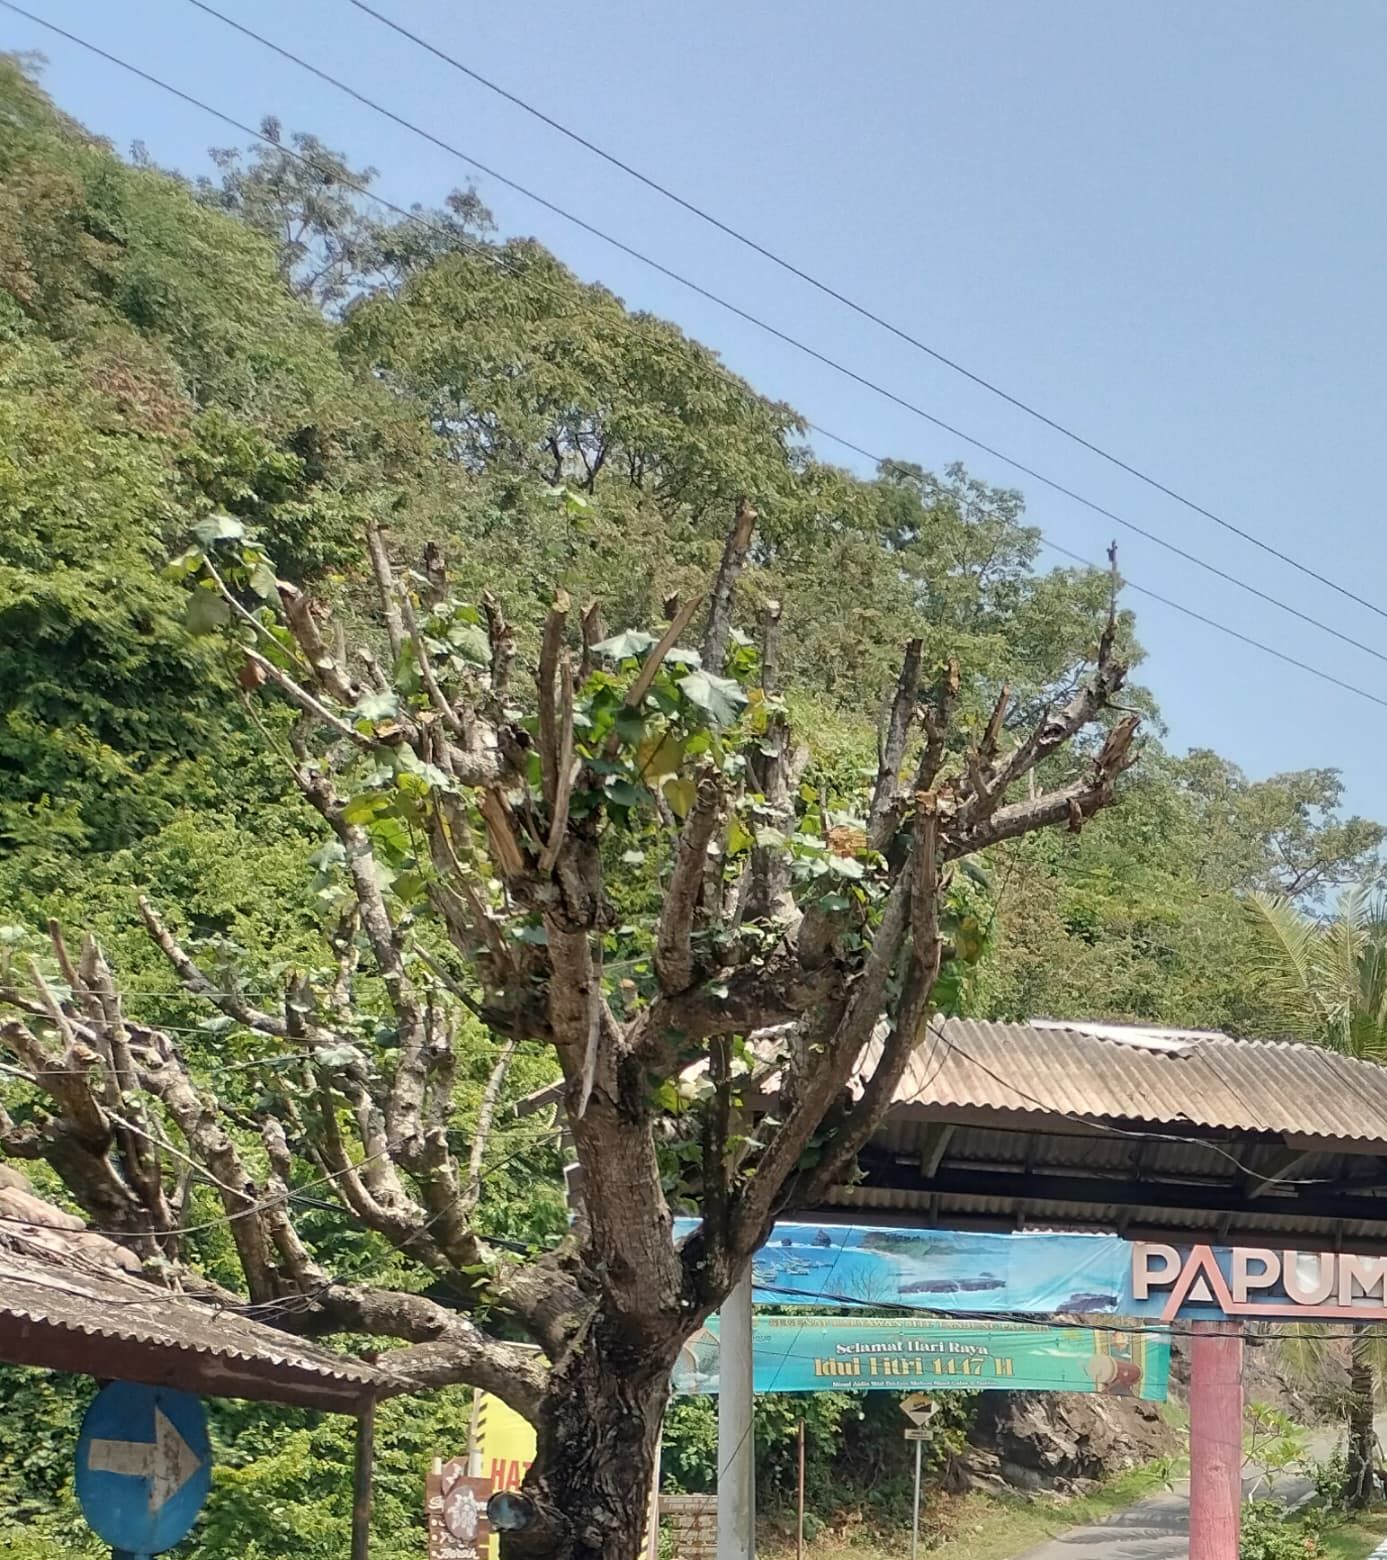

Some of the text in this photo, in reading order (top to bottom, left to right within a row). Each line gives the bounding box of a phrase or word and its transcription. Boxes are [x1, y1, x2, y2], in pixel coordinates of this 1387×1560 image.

[836, 1341, 989, 1358] Selamat Hari Raya
[814, 1356, 1015, 1377] Idul Fitri 1447 H
